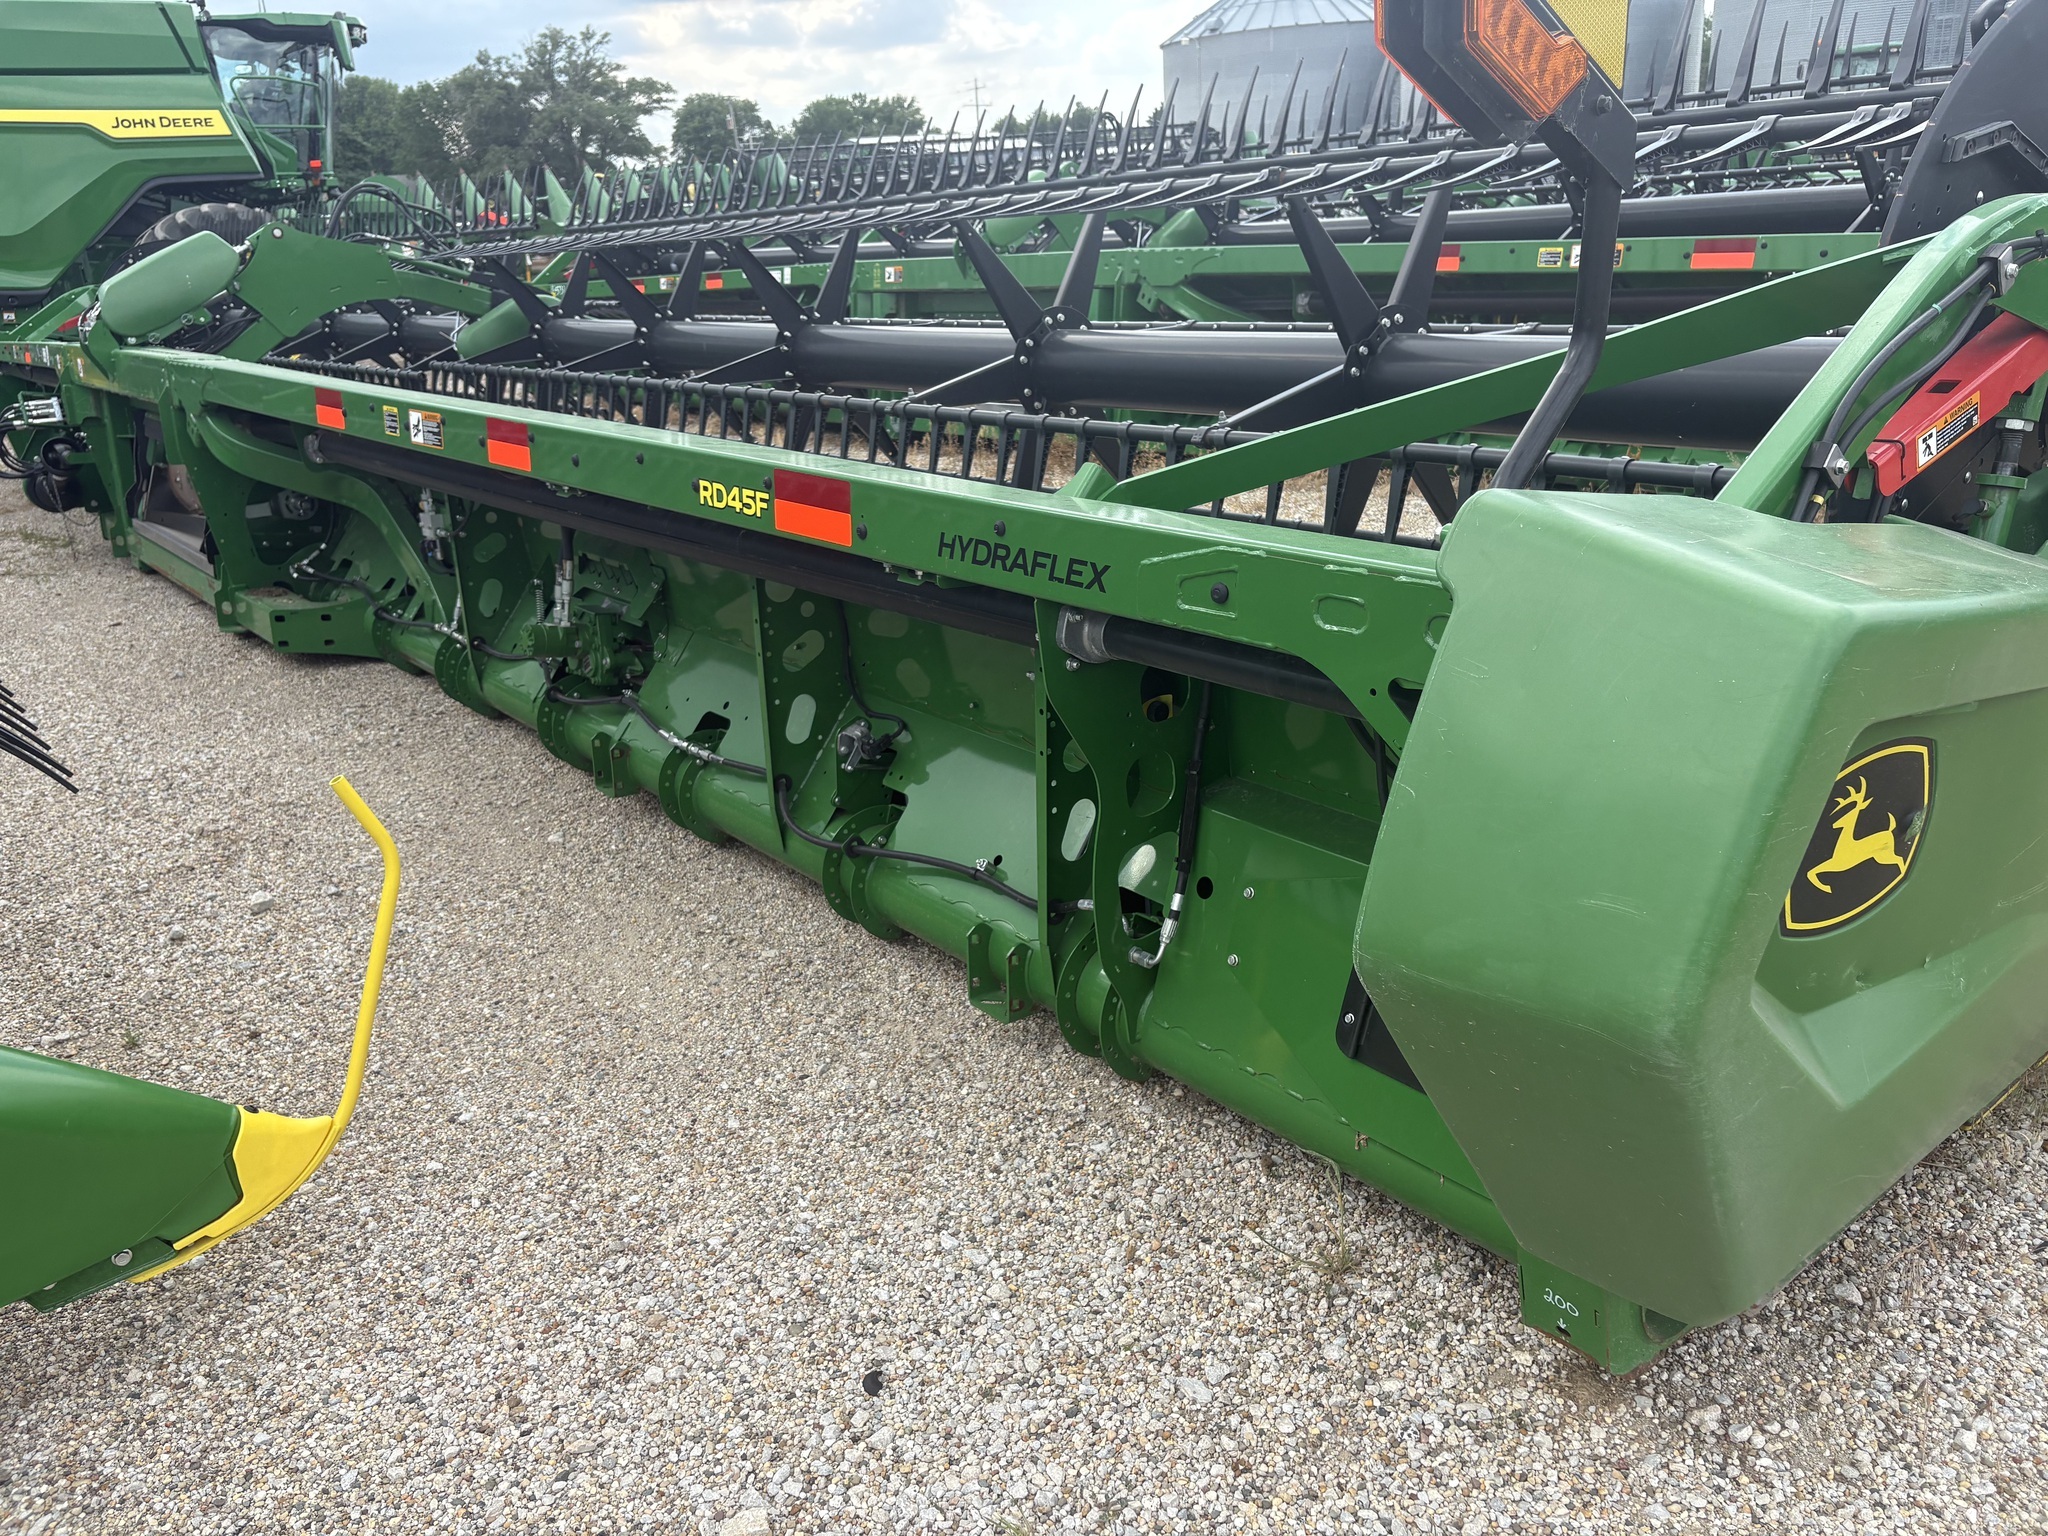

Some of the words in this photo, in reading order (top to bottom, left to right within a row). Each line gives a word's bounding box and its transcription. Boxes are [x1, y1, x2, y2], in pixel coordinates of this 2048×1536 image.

[111, 116, 156, 129] JOHN
[159, 116, 214, 128] DEERE
[1949, 397, 1973, 420] WARNING
[698, 478, 770, 518] RD45F
[937, 531, 1112, 594] HYDRAFLEX
[1543, 1287, 1579, 1317] 200
